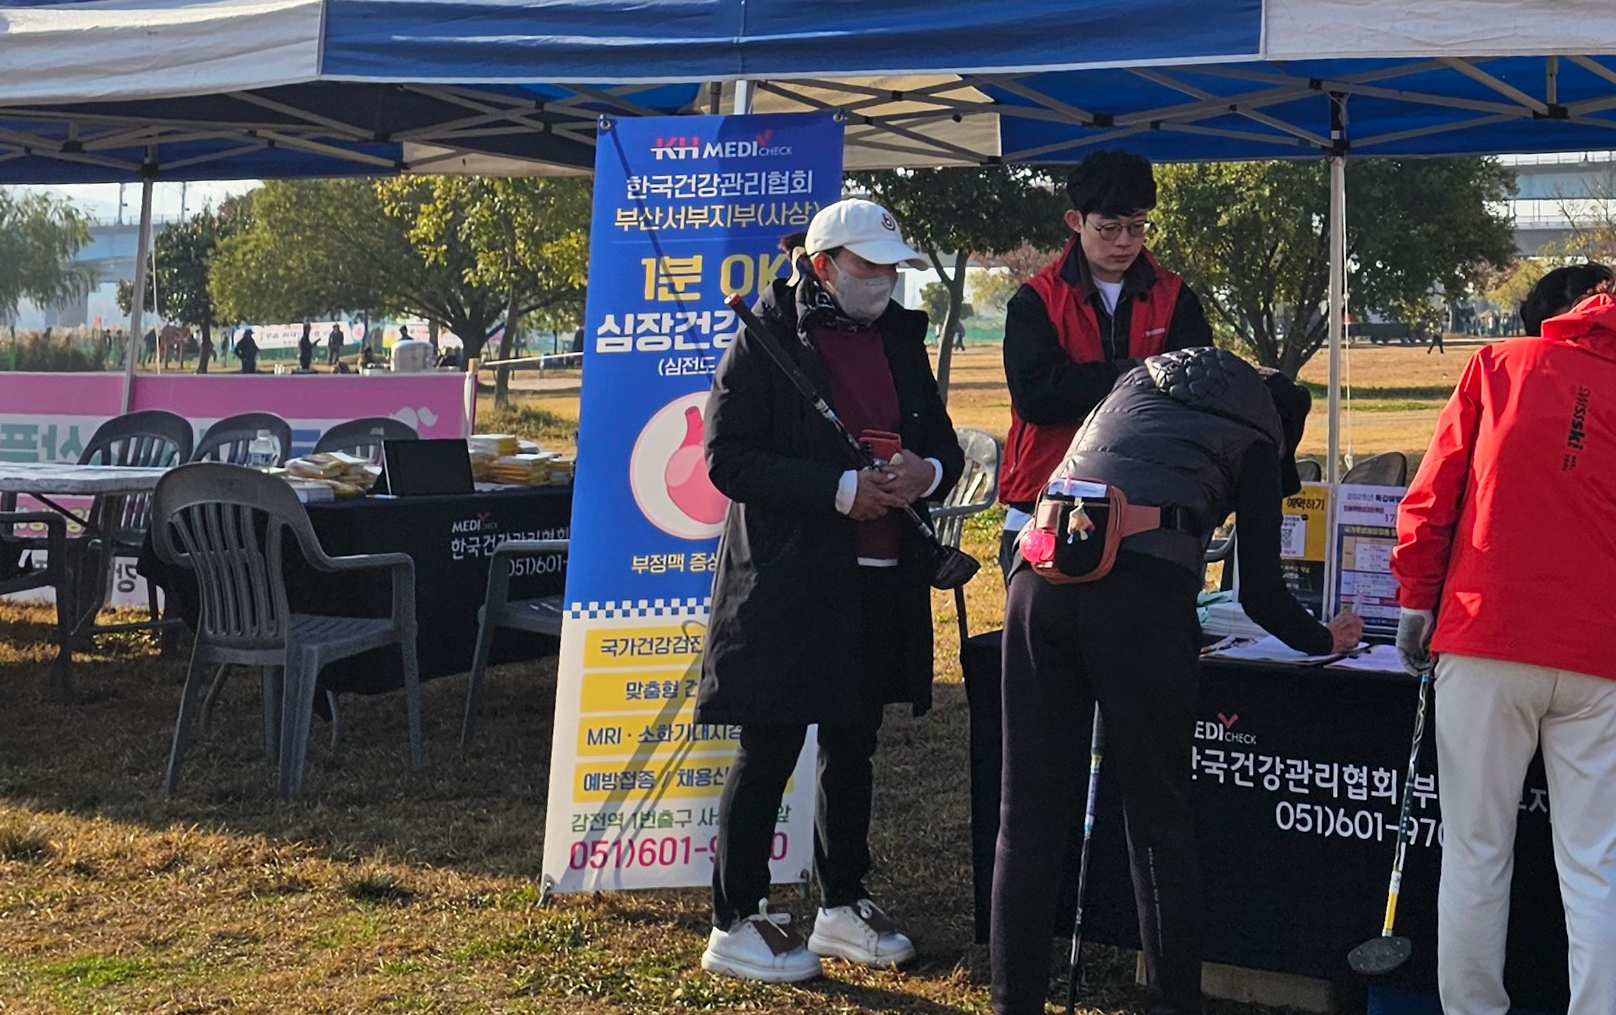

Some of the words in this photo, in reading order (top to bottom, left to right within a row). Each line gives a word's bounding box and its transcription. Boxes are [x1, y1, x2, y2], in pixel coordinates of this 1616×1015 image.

[626, 170, 814, 200] 한국건강관리협회
[641, 254, 703, 302] 1분
[631, 553, 685, 574] 부정맥
[626, 679, 680, 701] 맞춤형
[587, 727, 621, 745] MRI
[1194, 720, 1224, 741] EDI
[583, 769, 656, 792] 예방접종
[571, 811, 624, 833] 감전역
[631, 808, 693, 830] 1번출구
